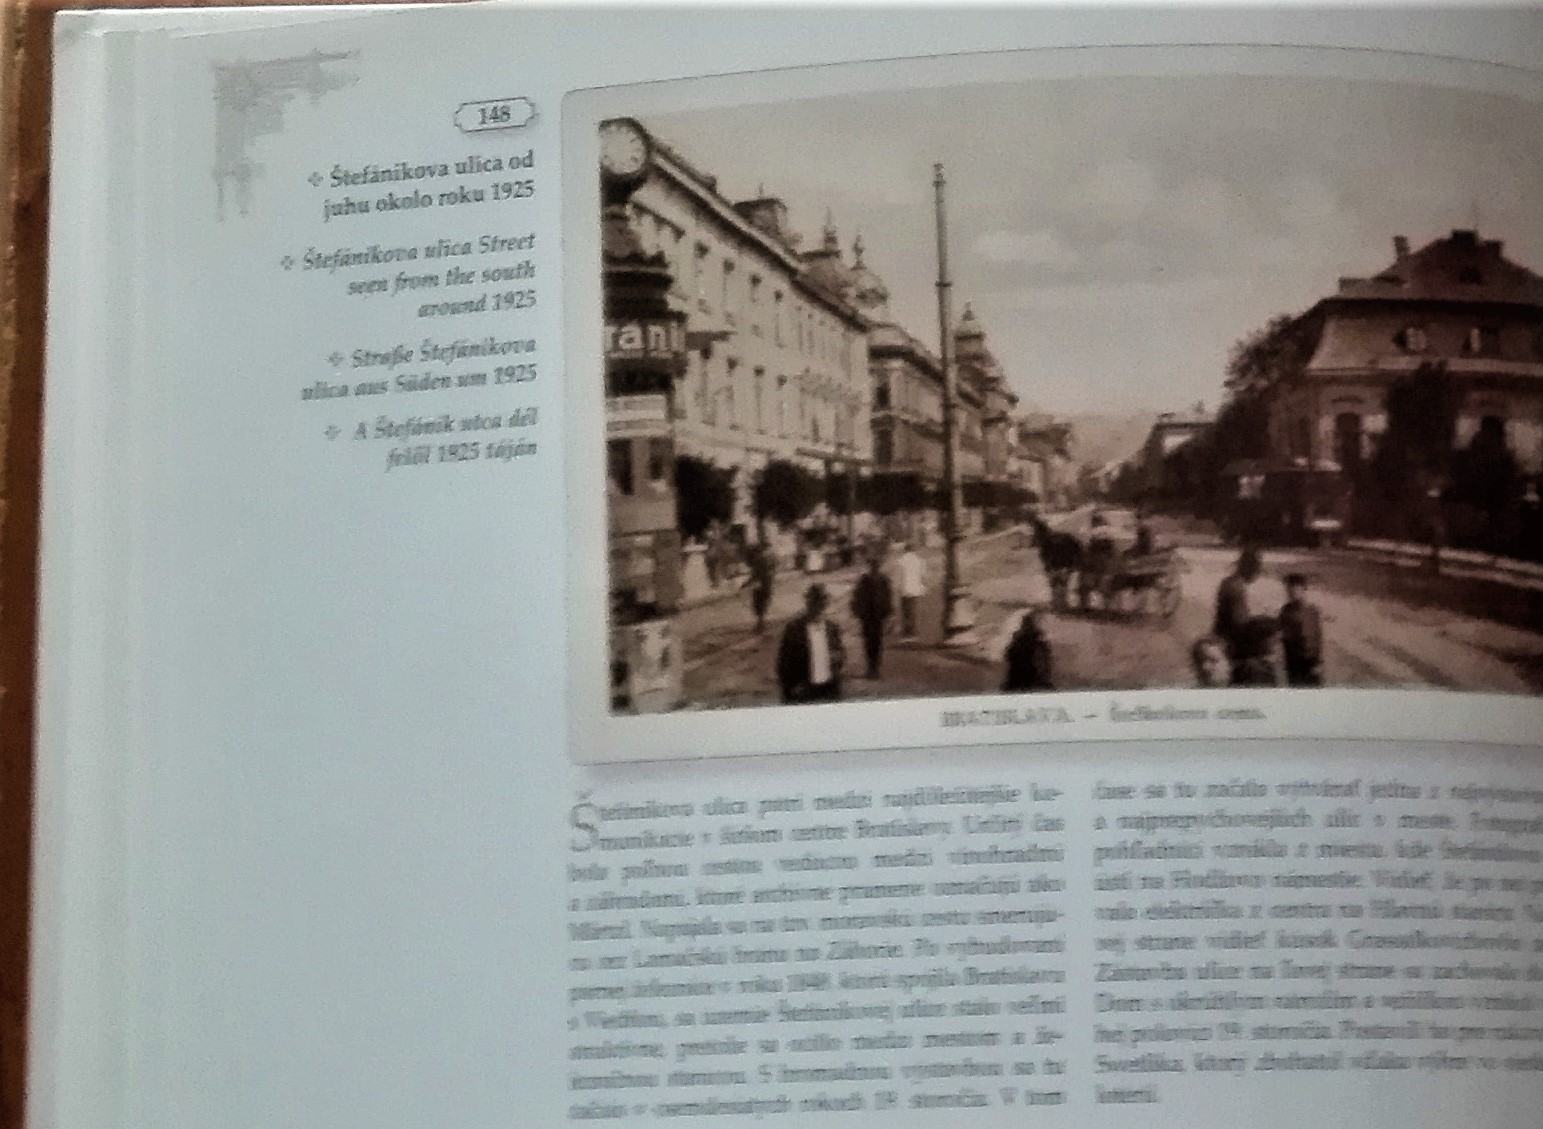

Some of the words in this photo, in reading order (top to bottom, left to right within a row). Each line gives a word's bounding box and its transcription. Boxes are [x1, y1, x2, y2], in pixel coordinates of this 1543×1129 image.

[456, 156, 503, 176] ulica
[509, 150, 534, 169] od
[324, 196, 370, 222] juhu
[376, 190, 432, 211] okolo
[438, 186, 484, 206] roku
[491, 180, 535, 199] 1925
[478, 233, 535, 253] Street
[446, 267, 475, 287] the
[492, 290, 536, 311] 1925
[494, 363, 537, 385] 1925
